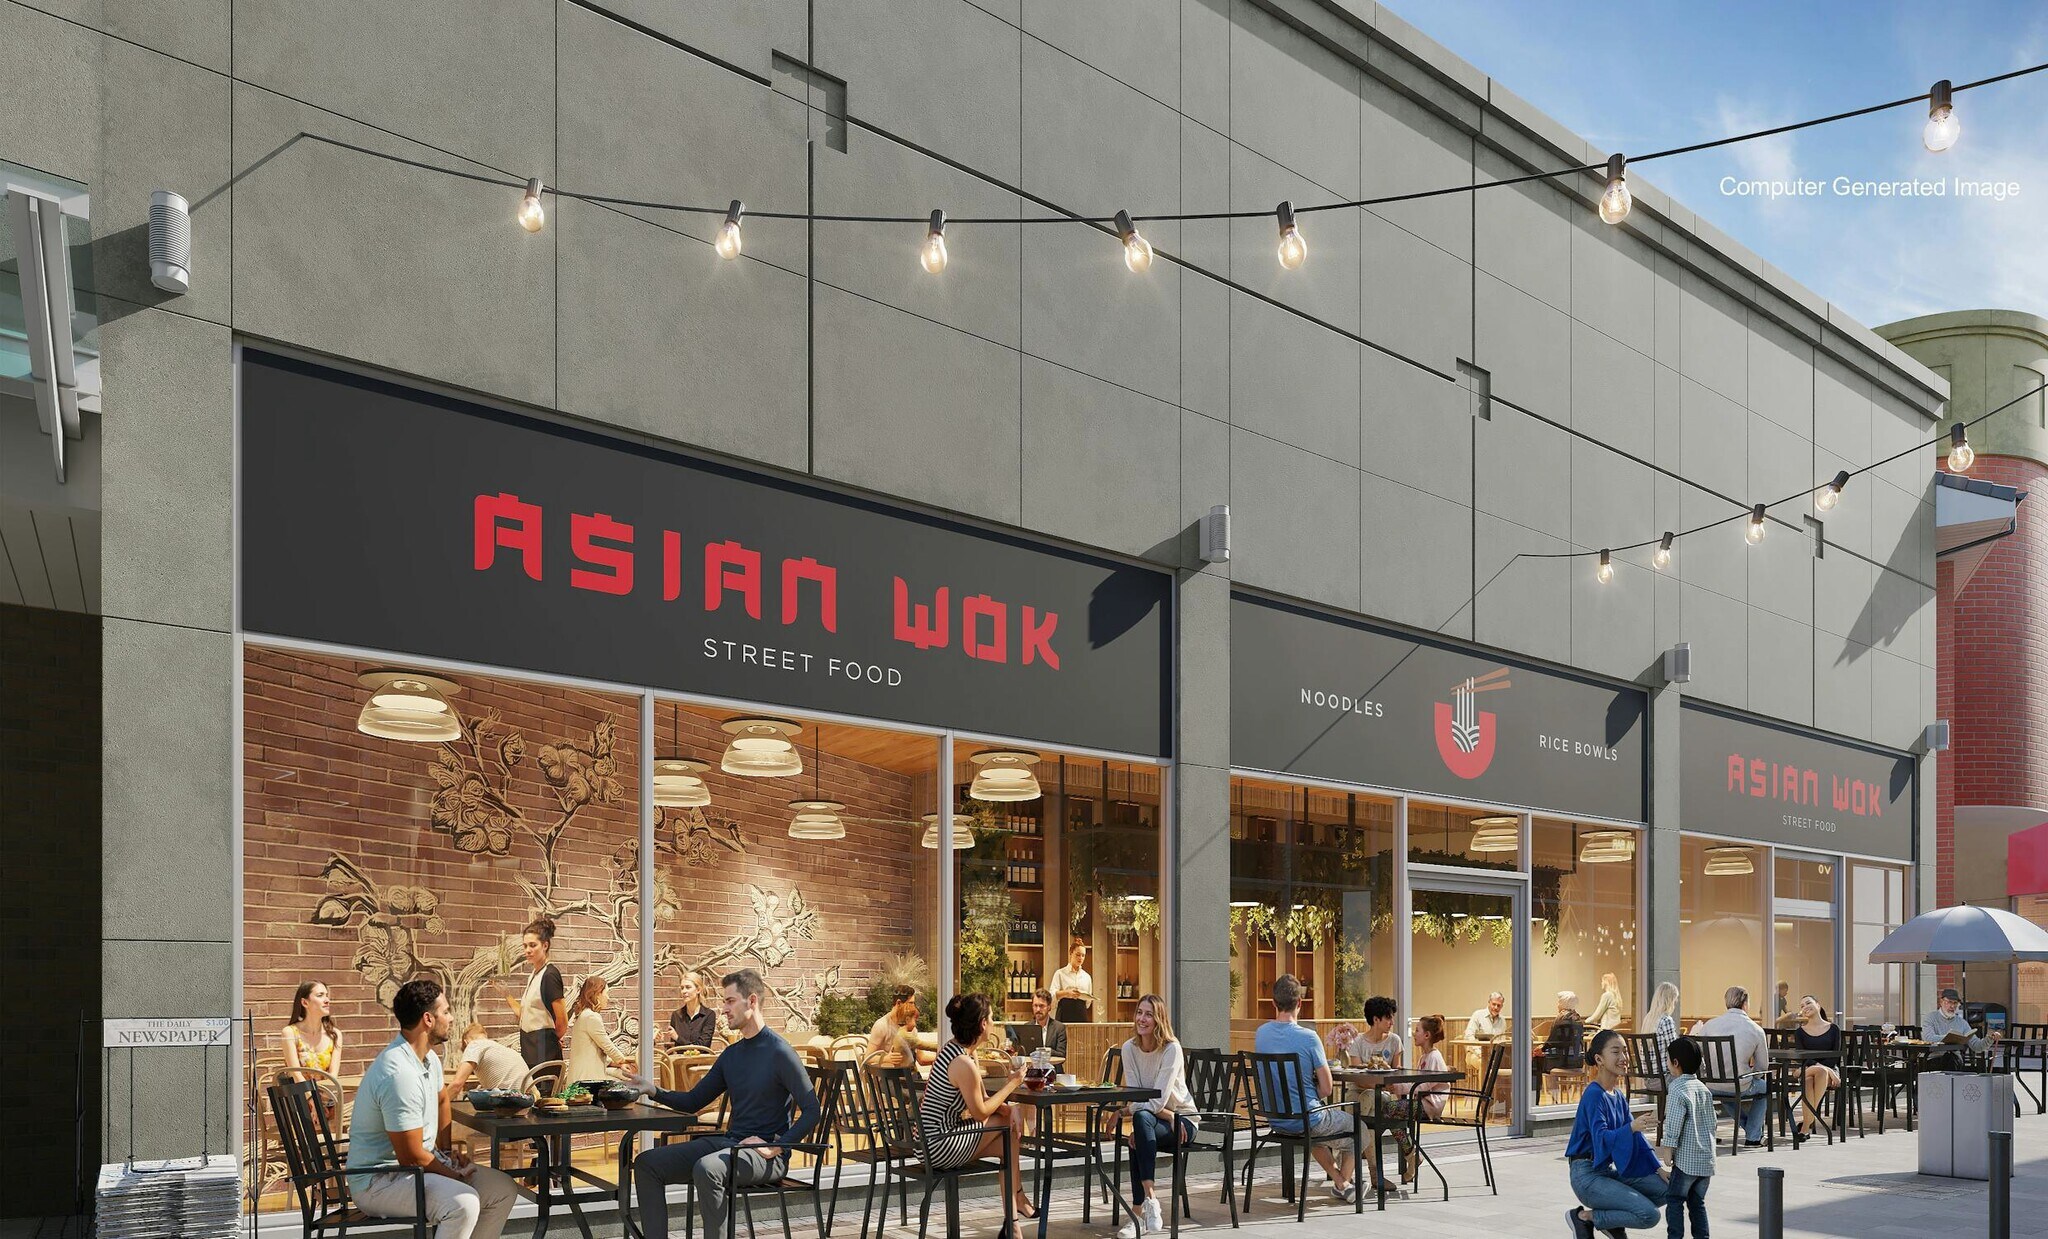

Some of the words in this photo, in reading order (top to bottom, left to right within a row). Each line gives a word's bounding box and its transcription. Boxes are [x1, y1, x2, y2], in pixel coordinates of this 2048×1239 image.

[474, 492, 838, 634] ASIAN
[893, 576, 1060, 671] WOK
[703, 638, 813, 673] STREET
[828, 658, 902, 687] FOOD
[1301, 687, 1384, 718] NOODLES
[1539, 734, 1569, 753] RICE
[1574, 741, 1618, 762] BOWLS
[1728, 753, 1819, 807] ASIAN
[1833, 774, 1882, 817] WOK
[1782, 814, 1812, 829] STREET
[1815, 820, 1837, 833] FOOD
[119, 1030, 219, 1043] NEWSPAPER
[167, 1020, 192, 1028] DAILY
